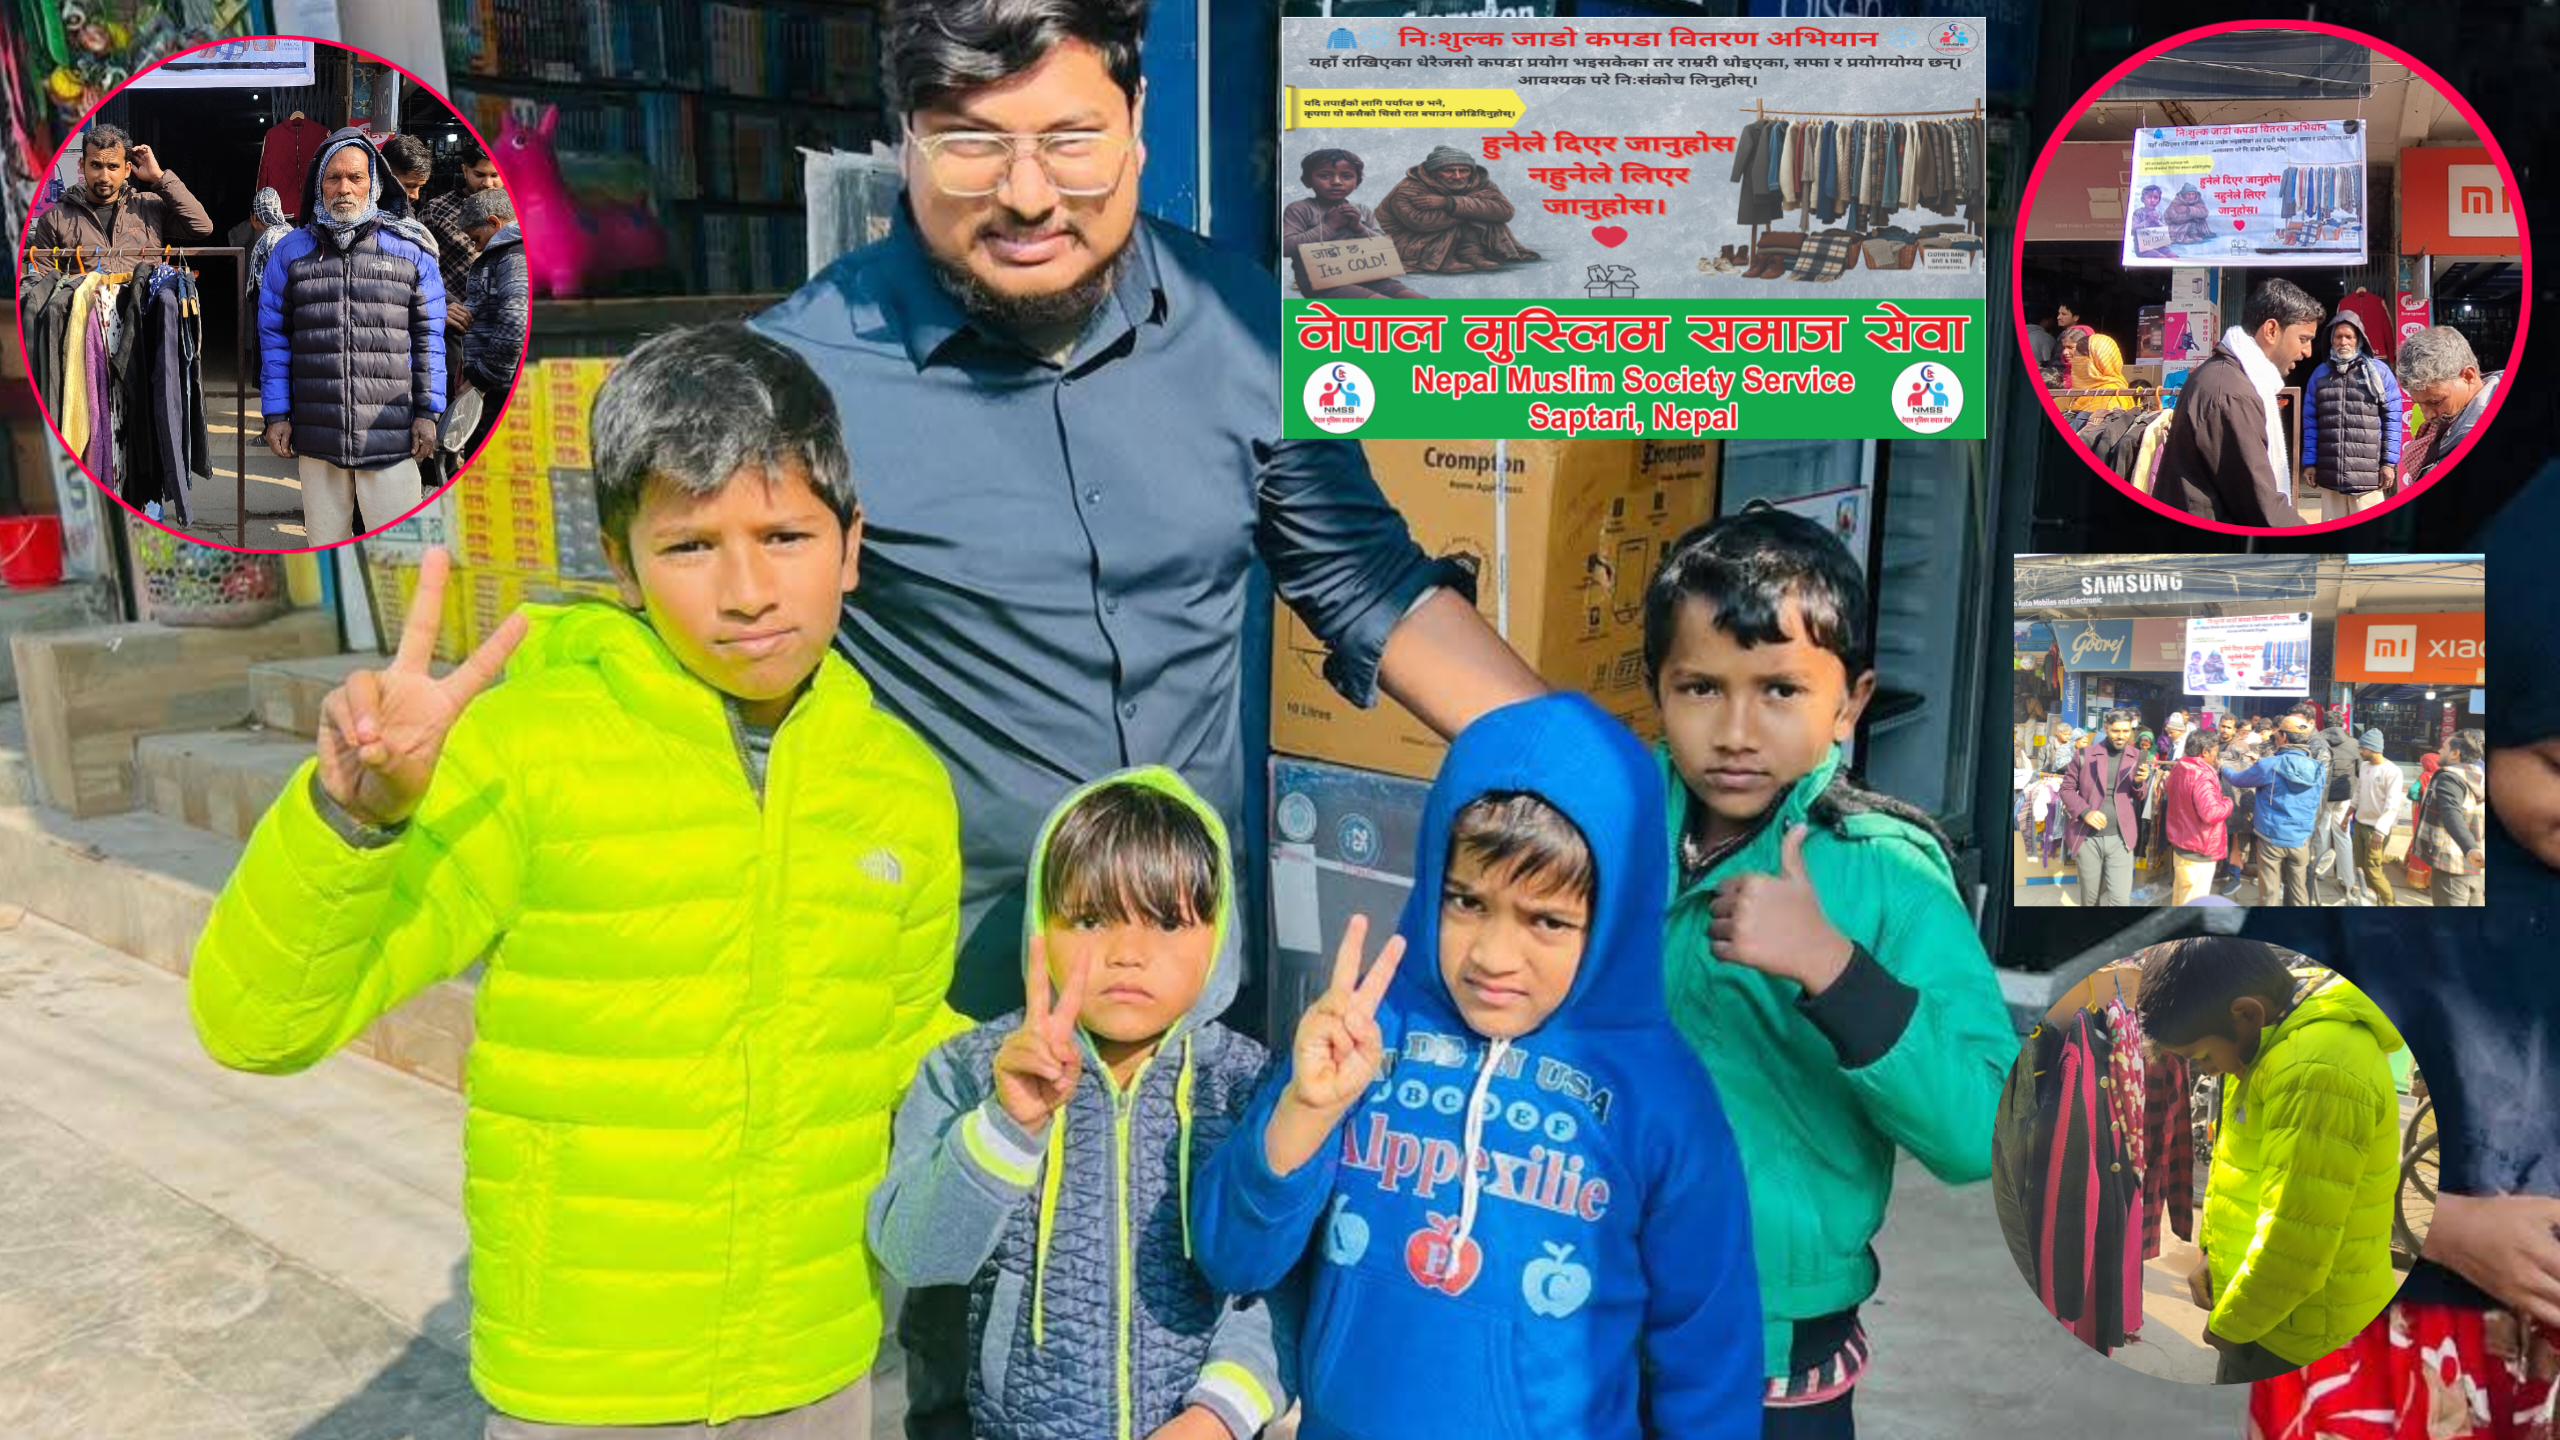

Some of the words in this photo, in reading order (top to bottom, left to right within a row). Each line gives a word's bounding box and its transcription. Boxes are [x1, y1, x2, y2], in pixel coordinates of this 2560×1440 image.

[2211, 124, 2231, 135] जाडो
[2234, 126, 2258, 134] कपडा
[2260, 123, 2289, 133] वितरण
[2291, 122, 2327, 132] अभियान
[2200, 174, 2220, 188] हुनेले
[2222, 173, 2243, 186] दिएर
[2245, 173, 2281, 186] जानुहोस
[2214, 189, 2241, 203] नहुनेले
[2243, 188, 2266, 200] लिएर
[2081, 572, 2183, 595] SAMSUNG
[2033, 598, 2057, 606] Mobiles
[2070, 596, 2103, 604] Electronic
[1536, 1056, 1612, 1123] USA
